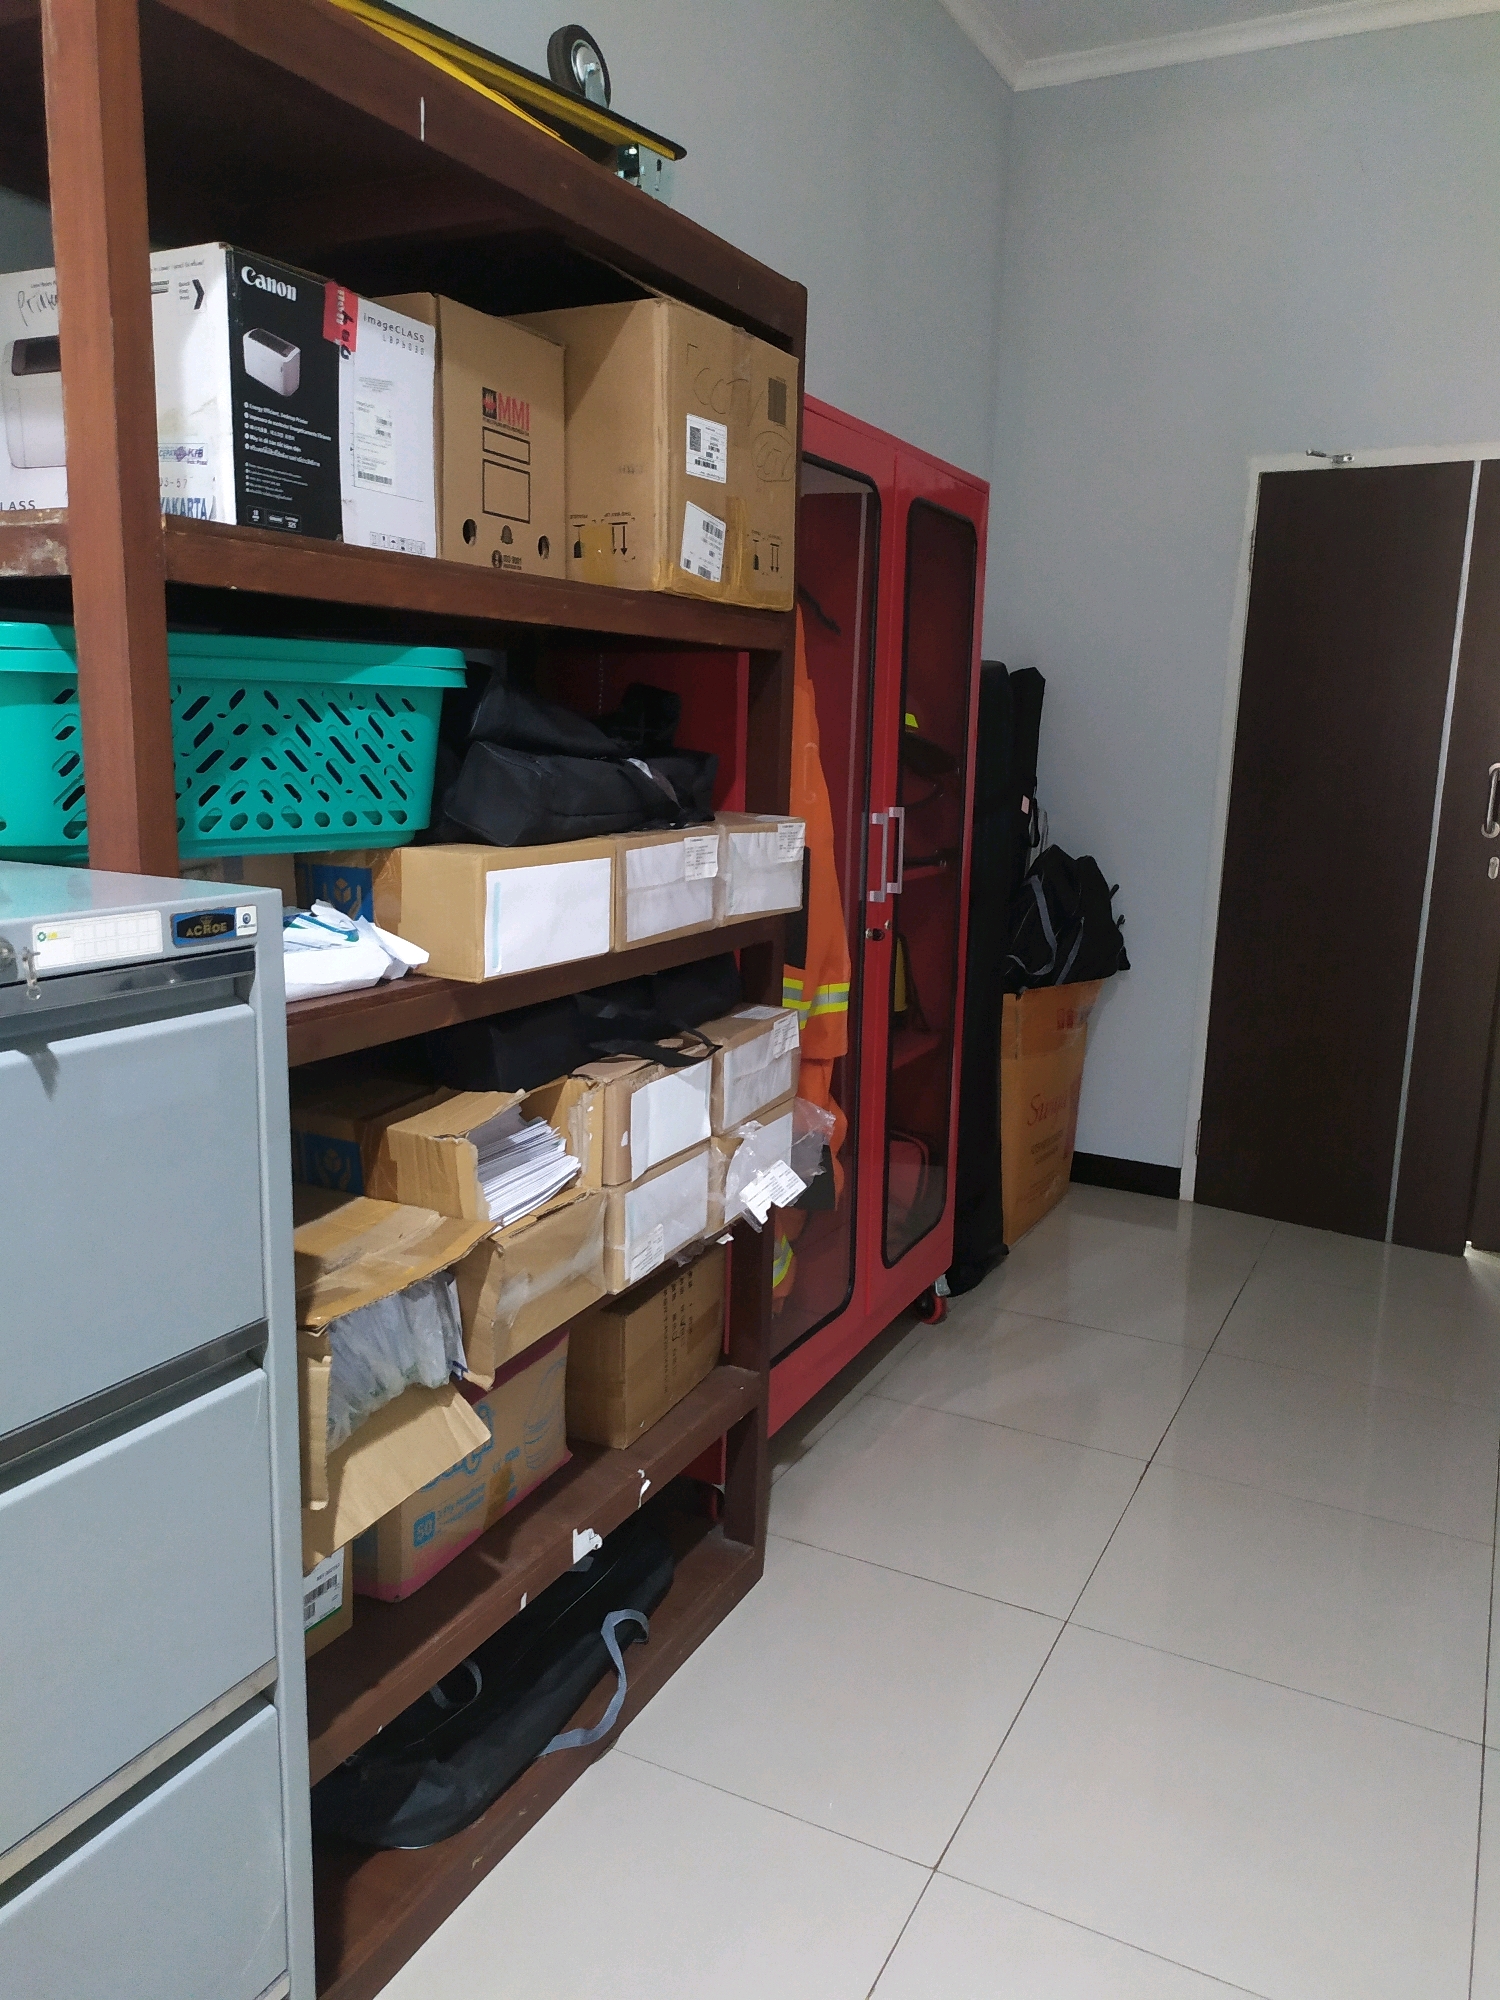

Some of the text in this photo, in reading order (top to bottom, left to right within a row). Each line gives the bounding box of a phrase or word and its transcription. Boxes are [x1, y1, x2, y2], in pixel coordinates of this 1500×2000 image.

[241, 265, 297, 302] Canon
[363, 312, 425, 343] imageCLASS
[497, 392, 530, 431] MMI
[186, 922, 227, 937] ACROE
